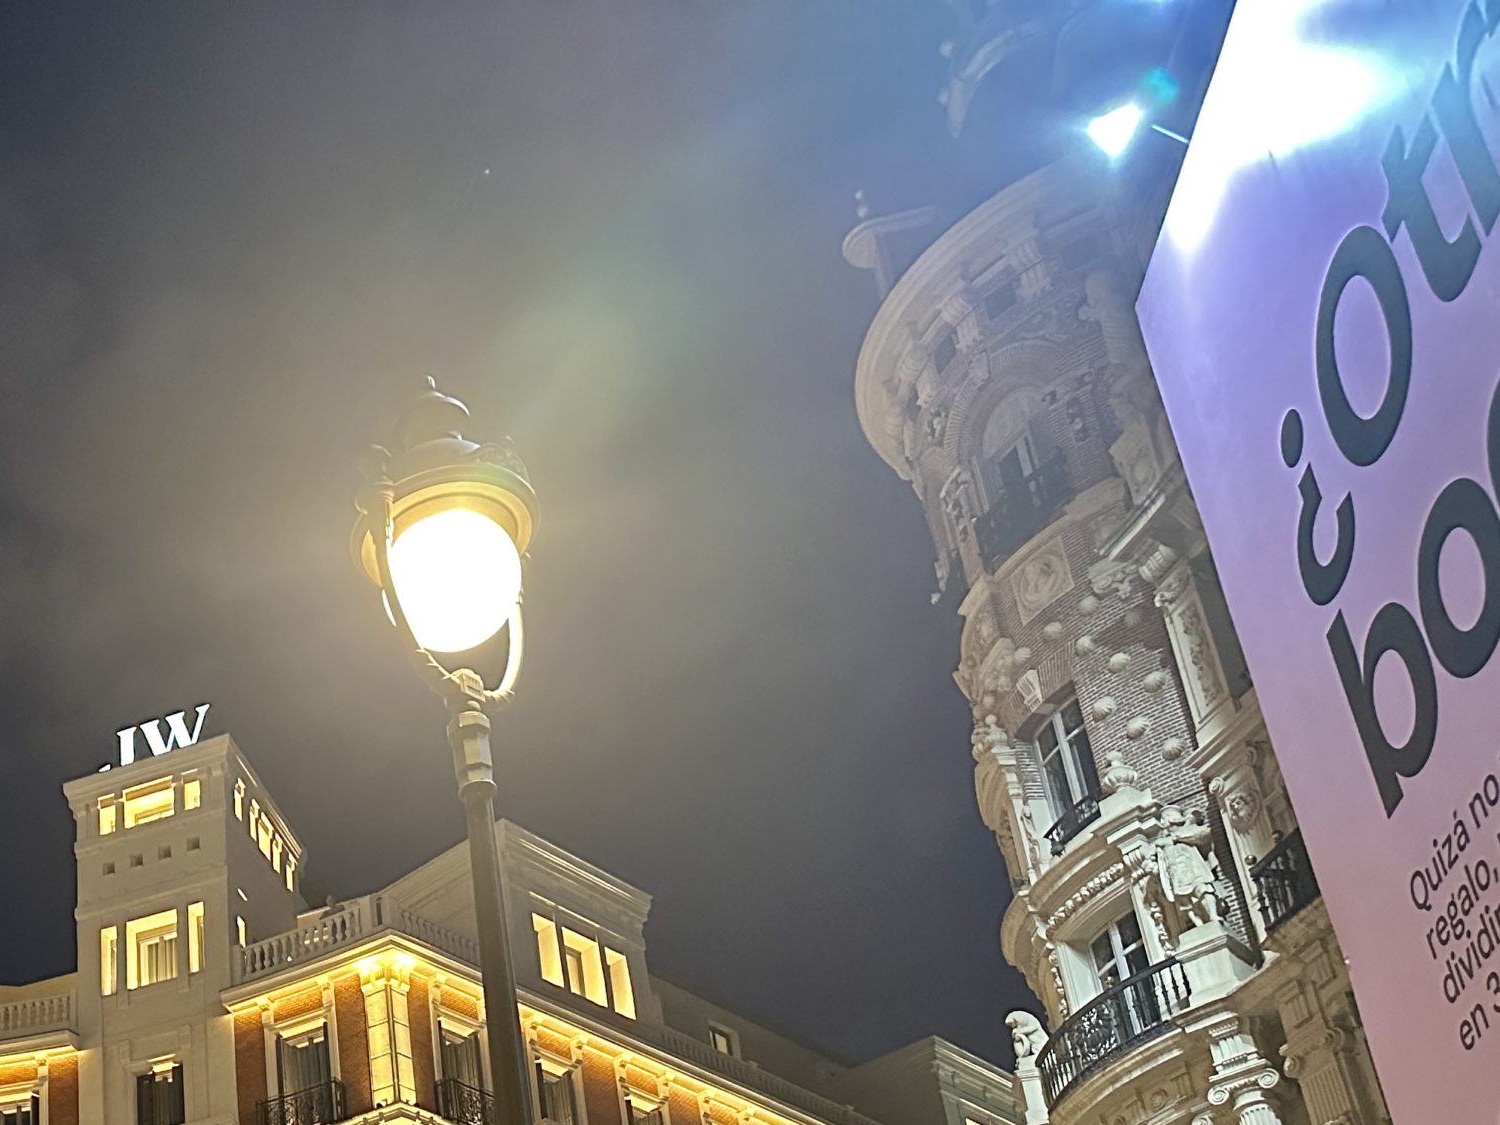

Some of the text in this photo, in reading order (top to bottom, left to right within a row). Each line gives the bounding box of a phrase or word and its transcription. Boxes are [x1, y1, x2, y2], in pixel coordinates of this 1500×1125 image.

[1410, 809, 1470, 912] Quizá
[1426, 859, 1499, 960] regalo,
[1459, 1003, 1490, 1050] en
